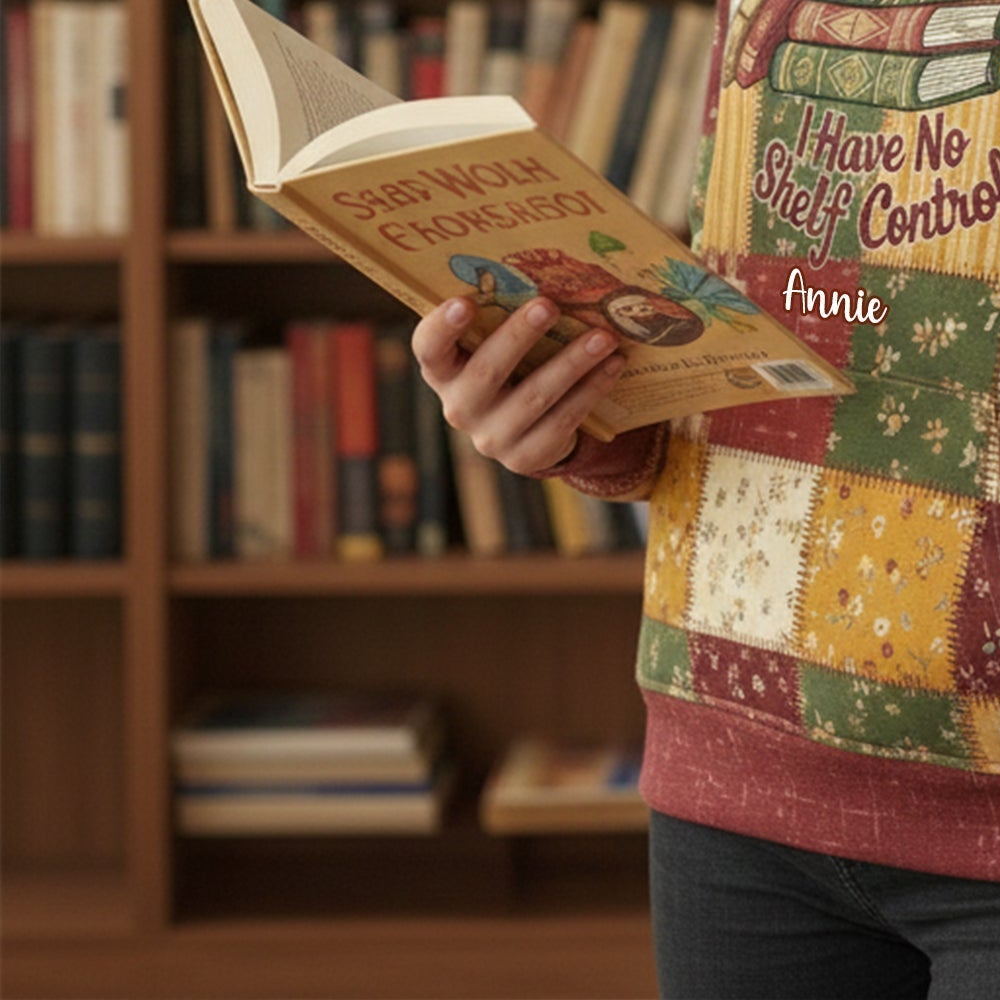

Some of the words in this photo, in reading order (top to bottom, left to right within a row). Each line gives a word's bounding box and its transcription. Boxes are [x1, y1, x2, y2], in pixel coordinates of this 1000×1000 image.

[796, 103, 815, 159] I
[812, 110, 906, 173] Have
[914, 112, 972, 172] No
[754, 141, 853, 269] Shelf
[782, 267, 889, 325] Annie
